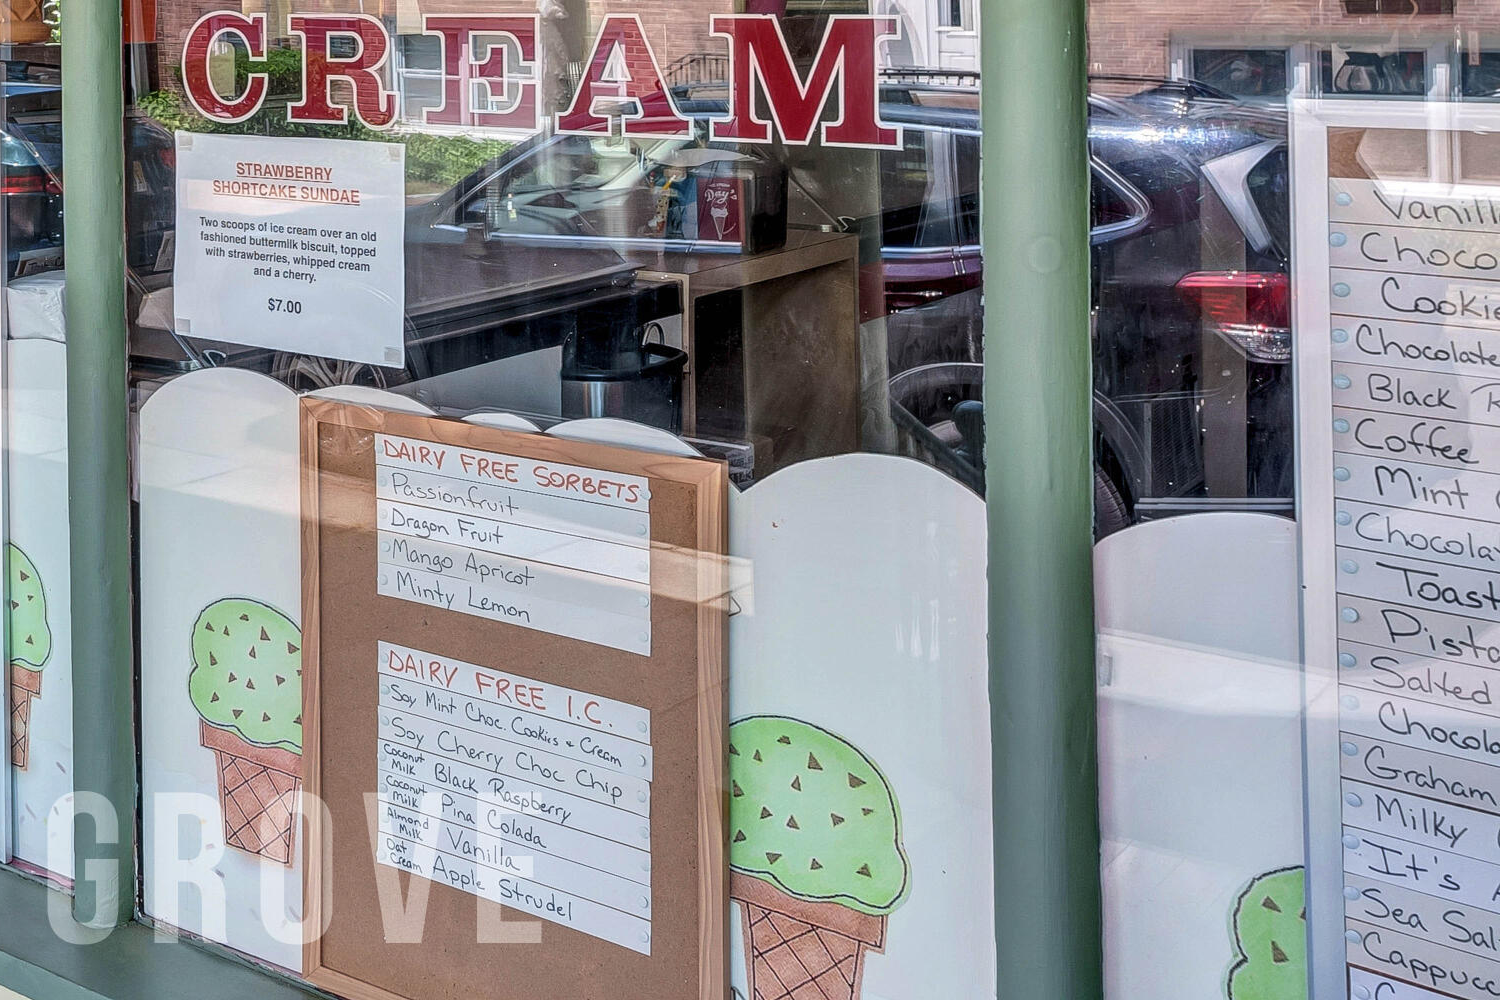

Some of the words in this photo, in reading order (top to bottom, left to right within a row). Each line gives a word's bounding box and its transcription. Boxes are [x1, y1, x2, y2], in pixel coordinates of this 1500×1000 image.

[181, 10, 904, 150] CREAM
[213, 180, 297, 198] SHORTCAKE
[301, 187, 360, 204] SUNDAE
[236, 162, 332, 182] STRAWBERRY
[199, 217, 219, 228] Two
[221, 219, 255, 232] scoops
[258, 222, 267, 232] of
[270, 223, 284, 234] ice
[287, 225, 317, 237] cream
[320, 229, 342, 239] over
[345, 232, 358, 241] an
[361, 231, 377, 242] old
[268, 298, 302, 314] $7.00
[1368, 373, 1457, 411] Black
[1354, 417, 1479, 465] Coffee
[383, 439, 445, 471] DAIRY
[461, 453, 519, 482] FREE
[533, 467, 640, 503] SORBETS
[391, 472, 519, 516] Passionfruit
[1374, 465, 1469, 510] Mint
[390, 509, 449, 538] Dragon
[457, 519, 504, 545] Fruit
[392, 538, 453, 570] Mango
[465, 552, 535, 587] Apricot
[396, 570, 455, 610] Minty
[468, 585, 530, 624] Lemon
[388, 649, 458, 688] DAIRY
[475, 671, 547, 711] FREE
[567, 695, 614, 728] I.C.
[1370, 656, 1491, 705] Salted
[391, 716, 424, 749] Soy
[437, 731, 503, 770] Cherry
[516, 752, 565, 783] Choc
[576, 769, 623, 802] Chip
[1363, 745, 1497, 807] Graham
[434, 762, 479, 794] Black
[488, 778, 571, 824] Raspberry
[1375, 794, 1468, 849] Milky
[446, 827, 521, 872] Vanilla
[1362, 838, 1460, 892] It's
[433, 855, 486, 892] Apple
[498, 879, 572, 922] Strudel
[1361, 889, 1428, 932] Sea
